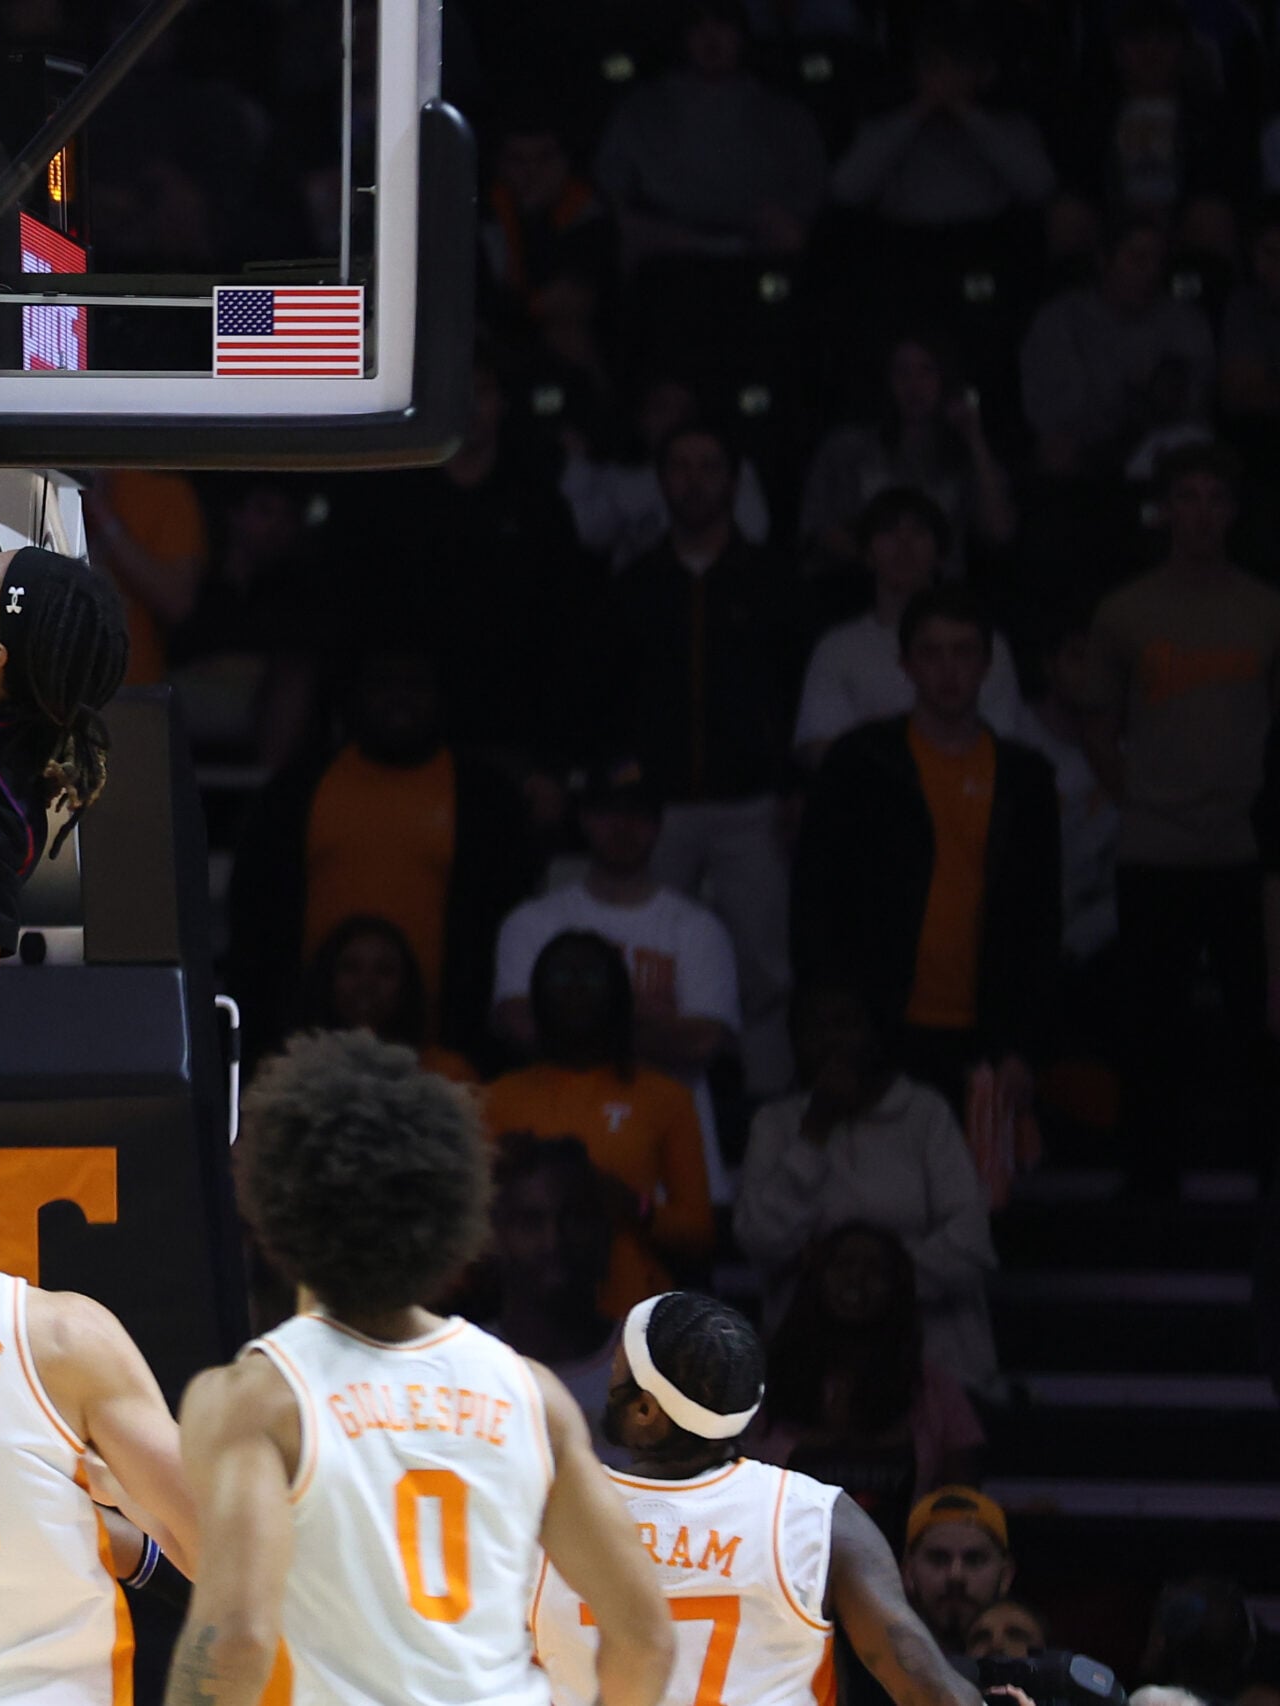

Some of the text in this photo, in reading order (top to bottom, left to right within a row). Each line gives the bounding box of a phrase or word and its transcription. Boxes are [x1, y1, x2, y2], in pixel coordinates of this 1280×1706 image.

[326, 1382, 512, 1447] GILLESPIE
[392, 1468, 475, 1625] 0
[634, 1522, 744, 1578] RAM
